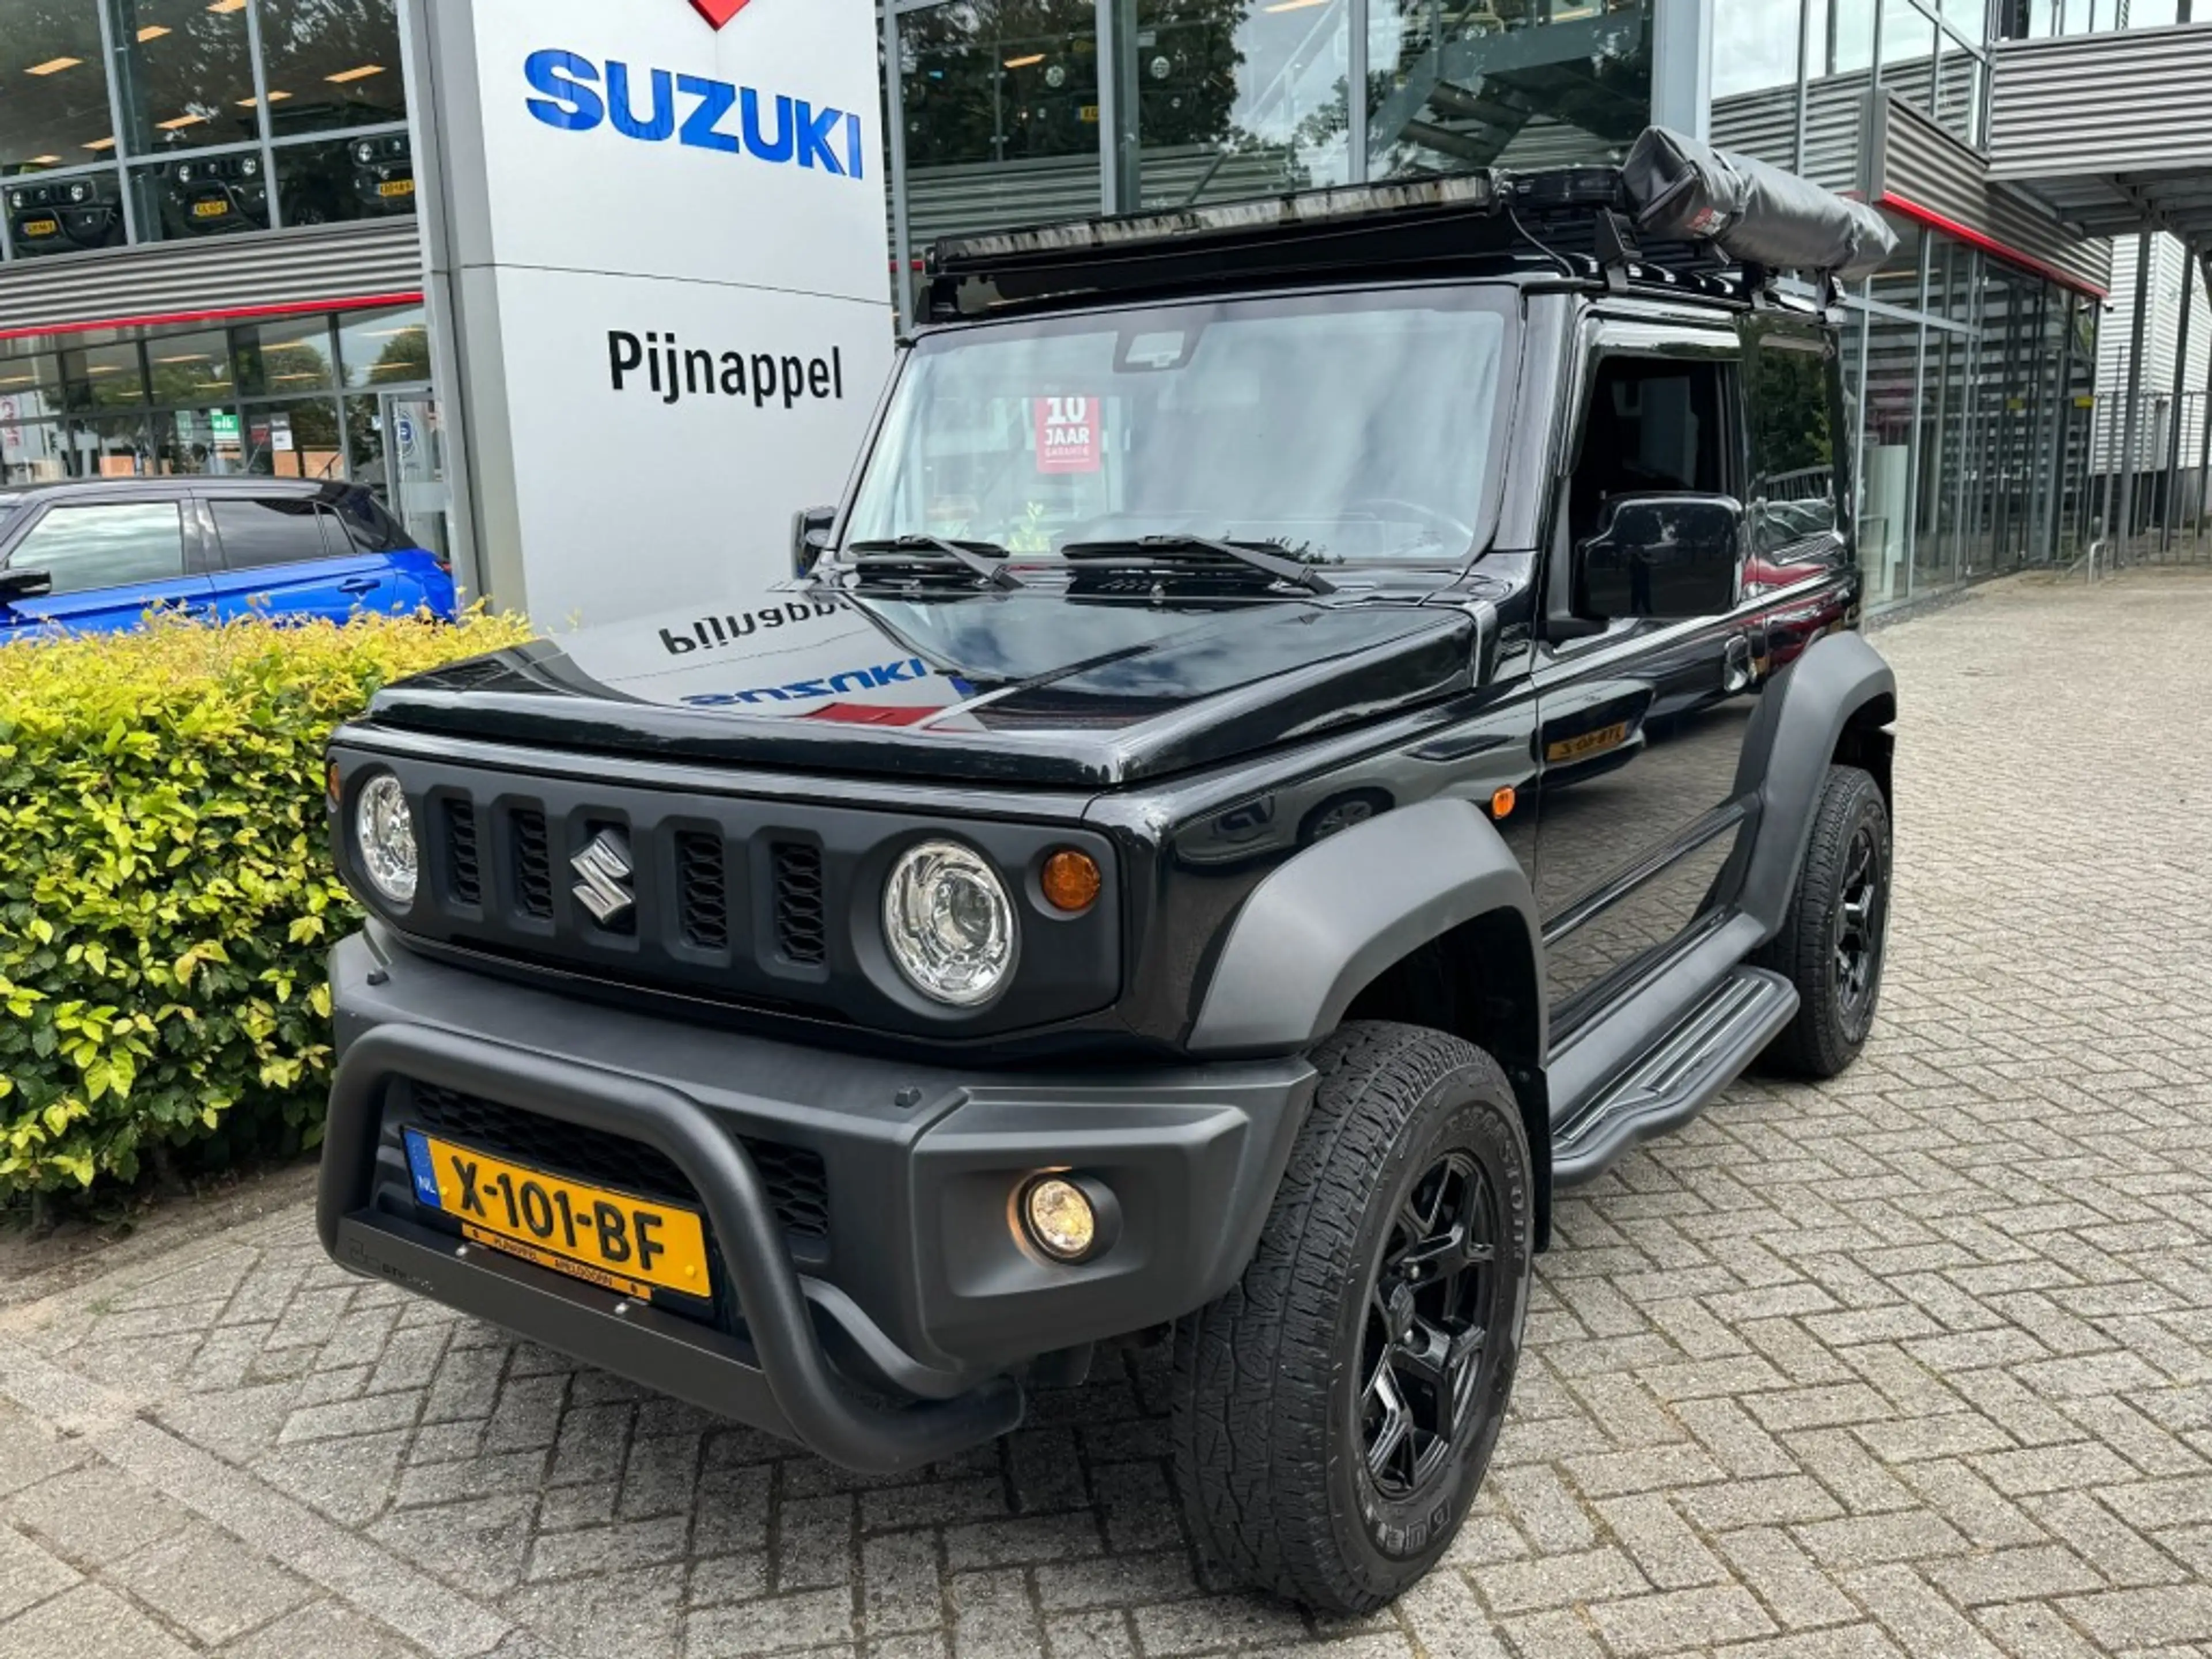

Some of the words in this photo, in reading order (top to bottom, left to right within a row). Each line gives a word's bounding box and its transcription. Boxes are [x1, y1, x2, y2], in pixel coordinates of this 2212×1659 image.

[524, 48, 863, 180] SUZUKI
[607, 330, 842, 409] Pijnappel
[1044, 426, 1090, 445] JAAR
[1046, 396, 1086, 423] 10
[417, 1175, 436, 1195] NL
[451, 1155, 664, 1271] X-101-BF
